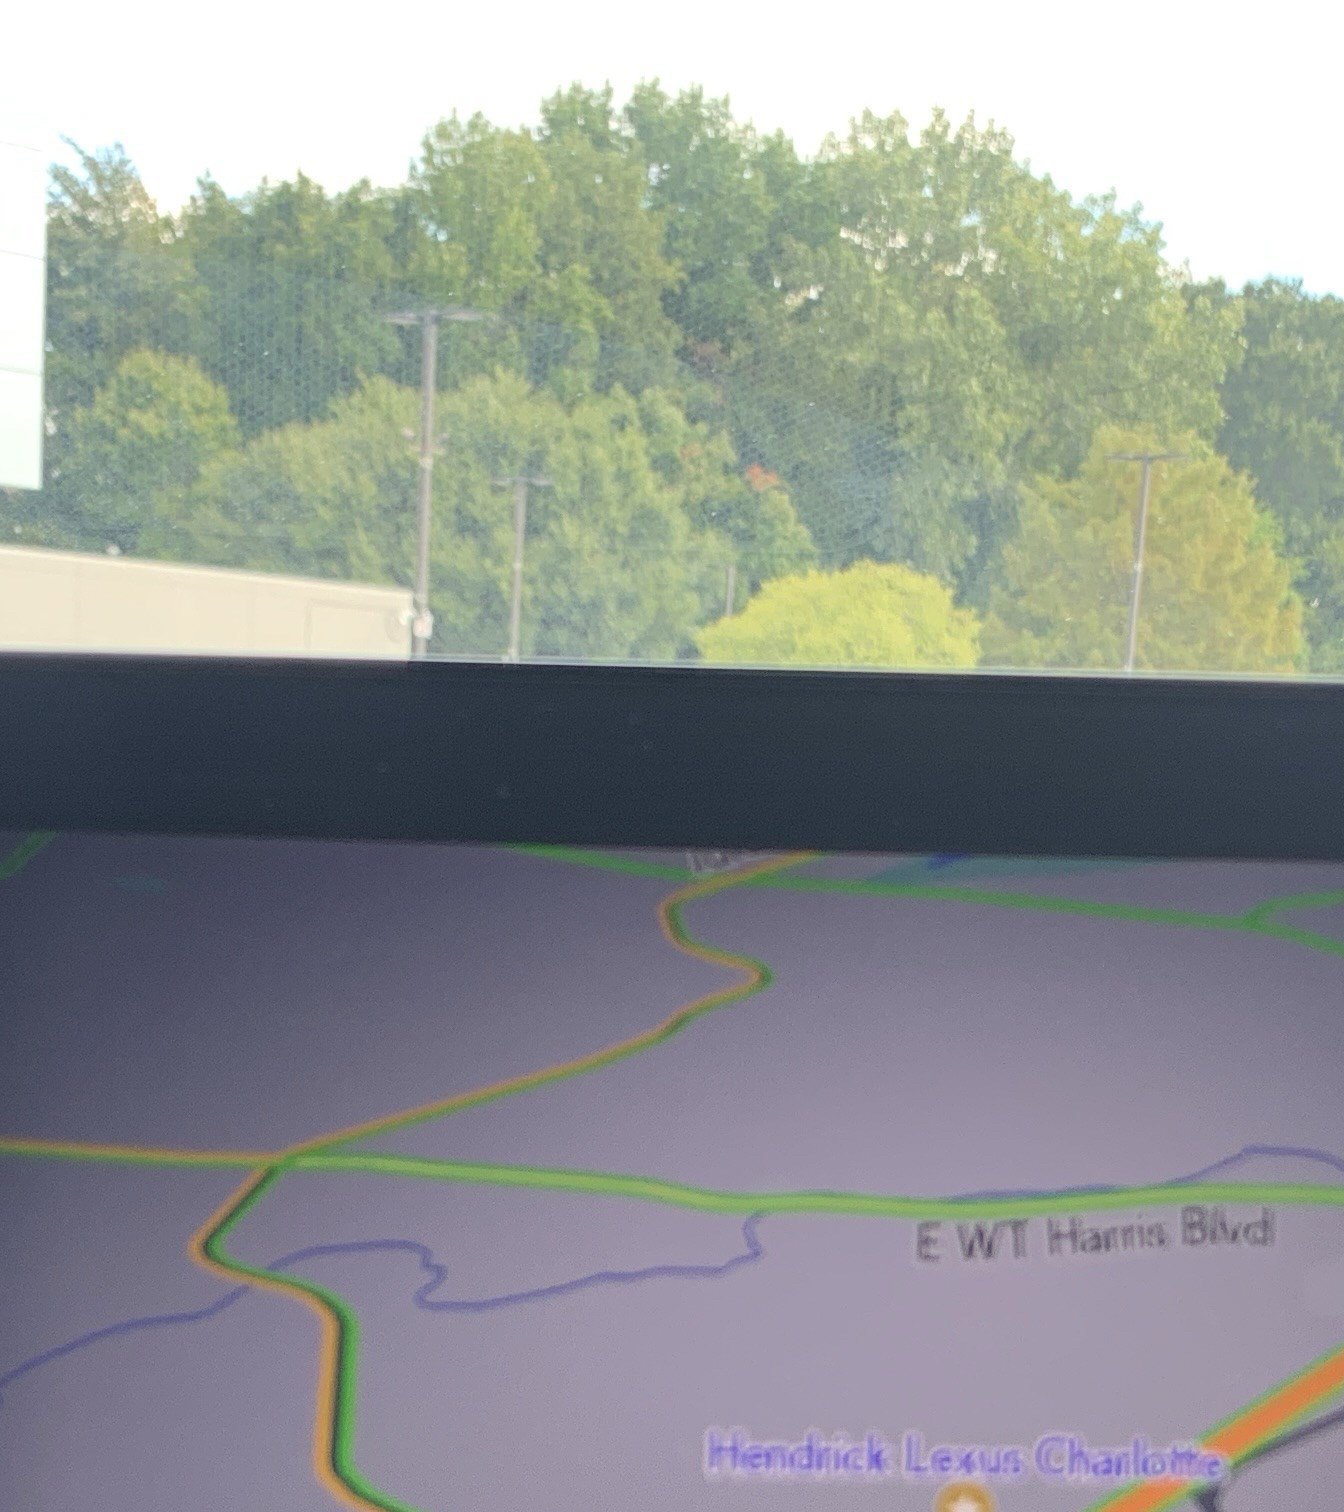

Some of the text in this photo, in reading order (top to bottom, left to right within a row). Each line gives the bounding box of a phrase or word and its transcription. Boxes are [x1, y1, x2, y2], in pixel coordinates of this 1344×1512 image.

[916, 1219, 942, 1263] E
[957, 1218, 1029, 1259] WT
[1180, 1203, 1276, 1248] Blvd
[706, 1431, 1222, 1480] Hendrick Lexus Charlotte
